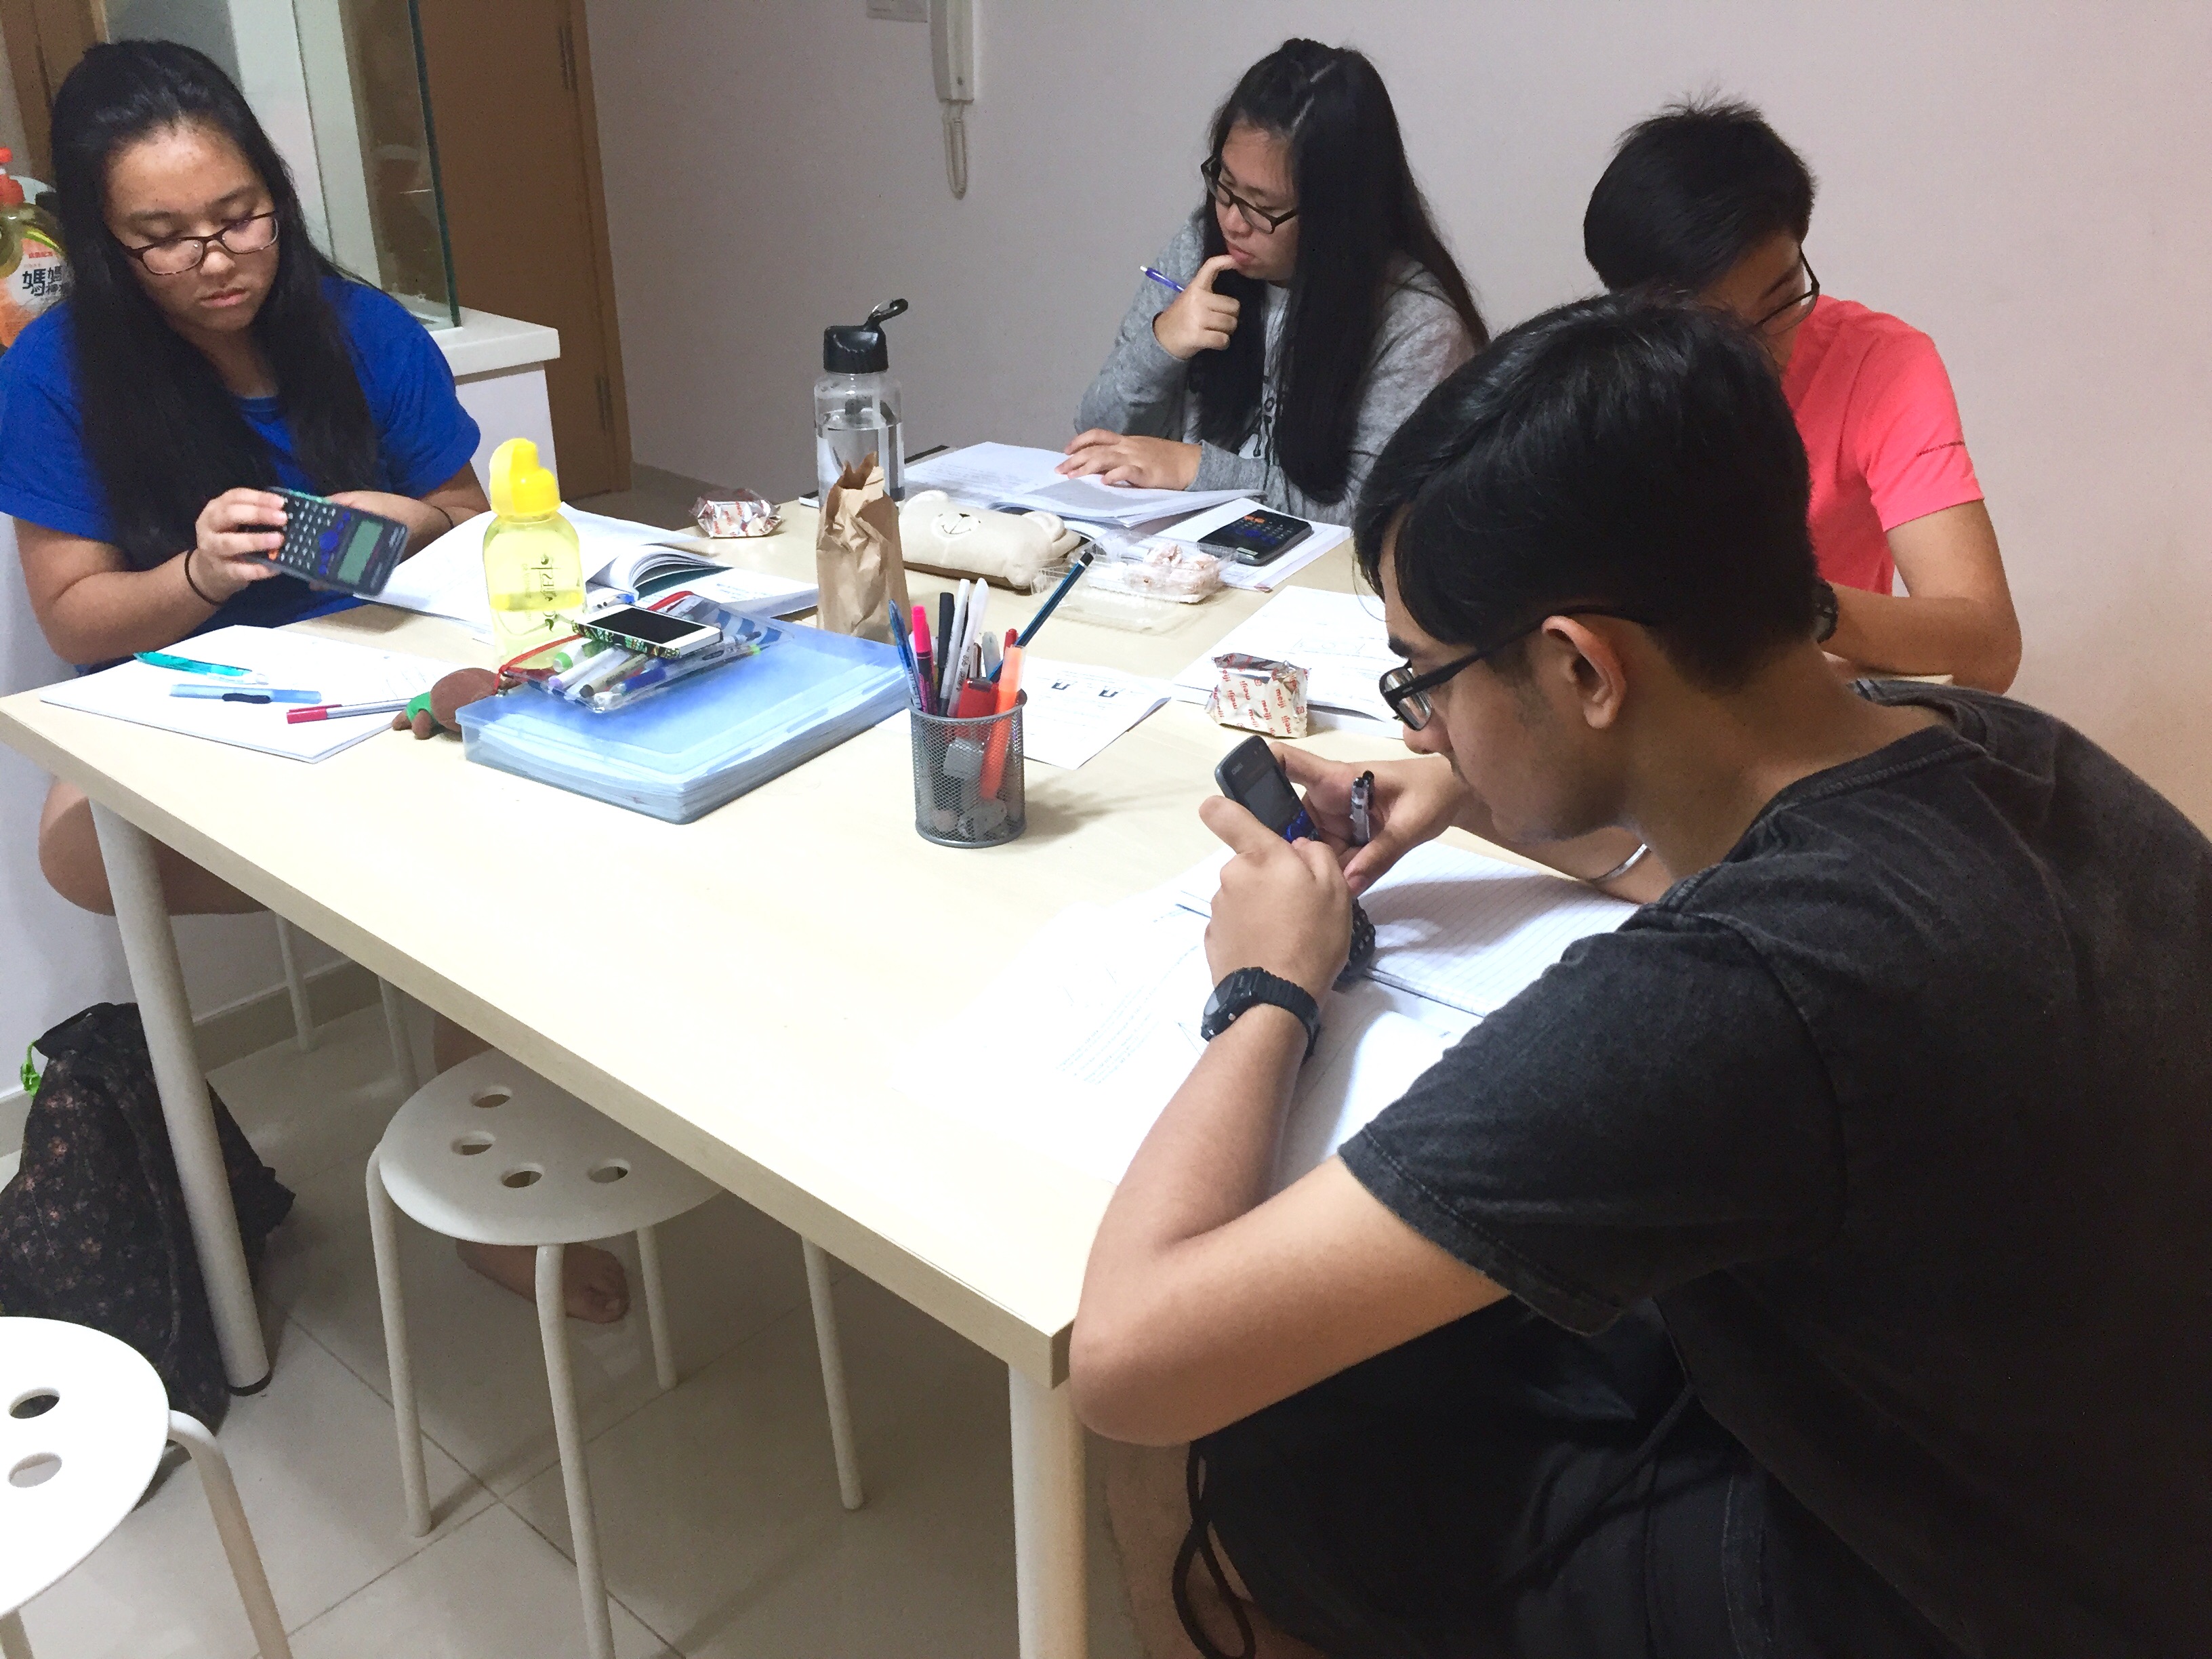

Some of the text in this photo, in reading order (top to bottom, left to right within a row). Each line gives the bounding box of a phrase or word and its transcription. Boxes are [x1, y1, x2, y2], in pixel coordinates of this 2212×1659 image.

[1227, 690, 1237, 710] meiji
[1240, 680, 1251, 700] meiji
[1276, 689, 1286, 709] meiji
[1248, 708, 1260, 728] meiji
[1261, 700, 1272, 720] meiji
[1282, 715, 1292, 734] meiji
